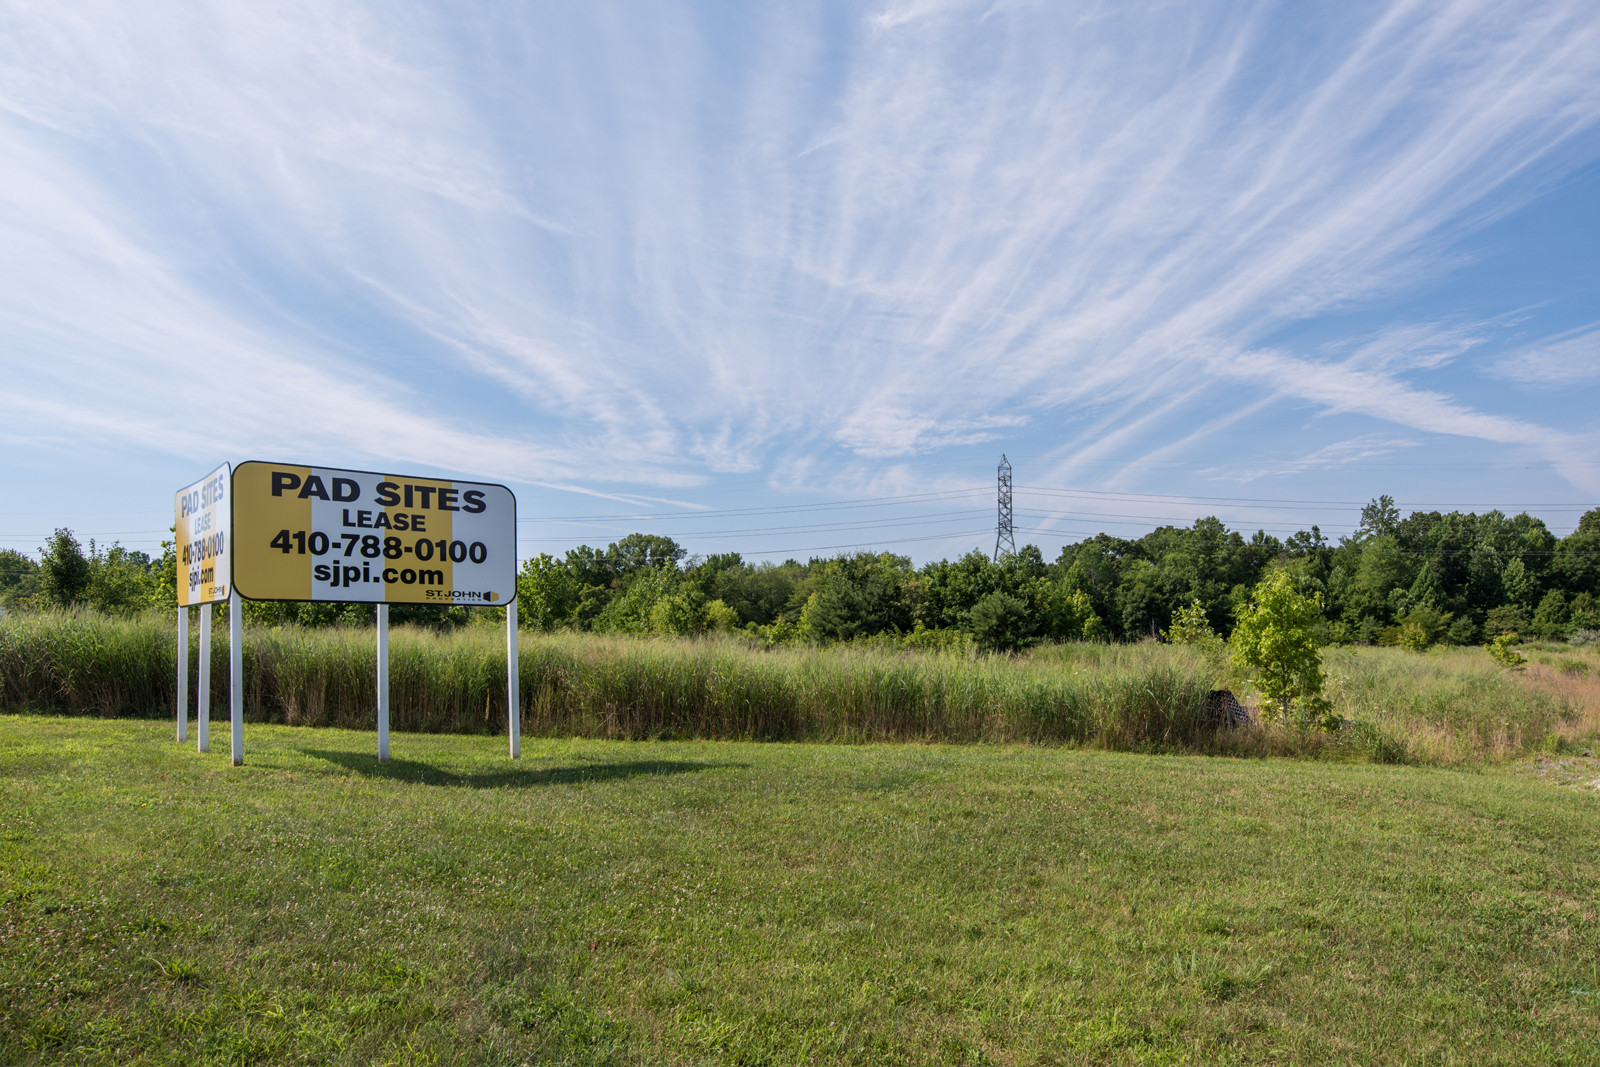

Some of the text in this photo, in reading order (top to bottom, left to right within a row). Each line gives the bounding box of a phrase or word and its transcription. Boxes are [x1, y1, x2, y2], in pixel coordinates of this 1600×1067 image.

[181, 474, 224, 518] PAD SITES
[270, 471, 487, 514] PAD SITES
[194, 512, 211, 535] LEASE
[342, 508, 427, 533] LEASE
[182, 530, 224, 566] 410-788-0100
[270, 529, 488, 564] 410-788-0100
[189, 565, 214, 592] sjpi.com
[313, 560, 444, 587] sjpi.com
